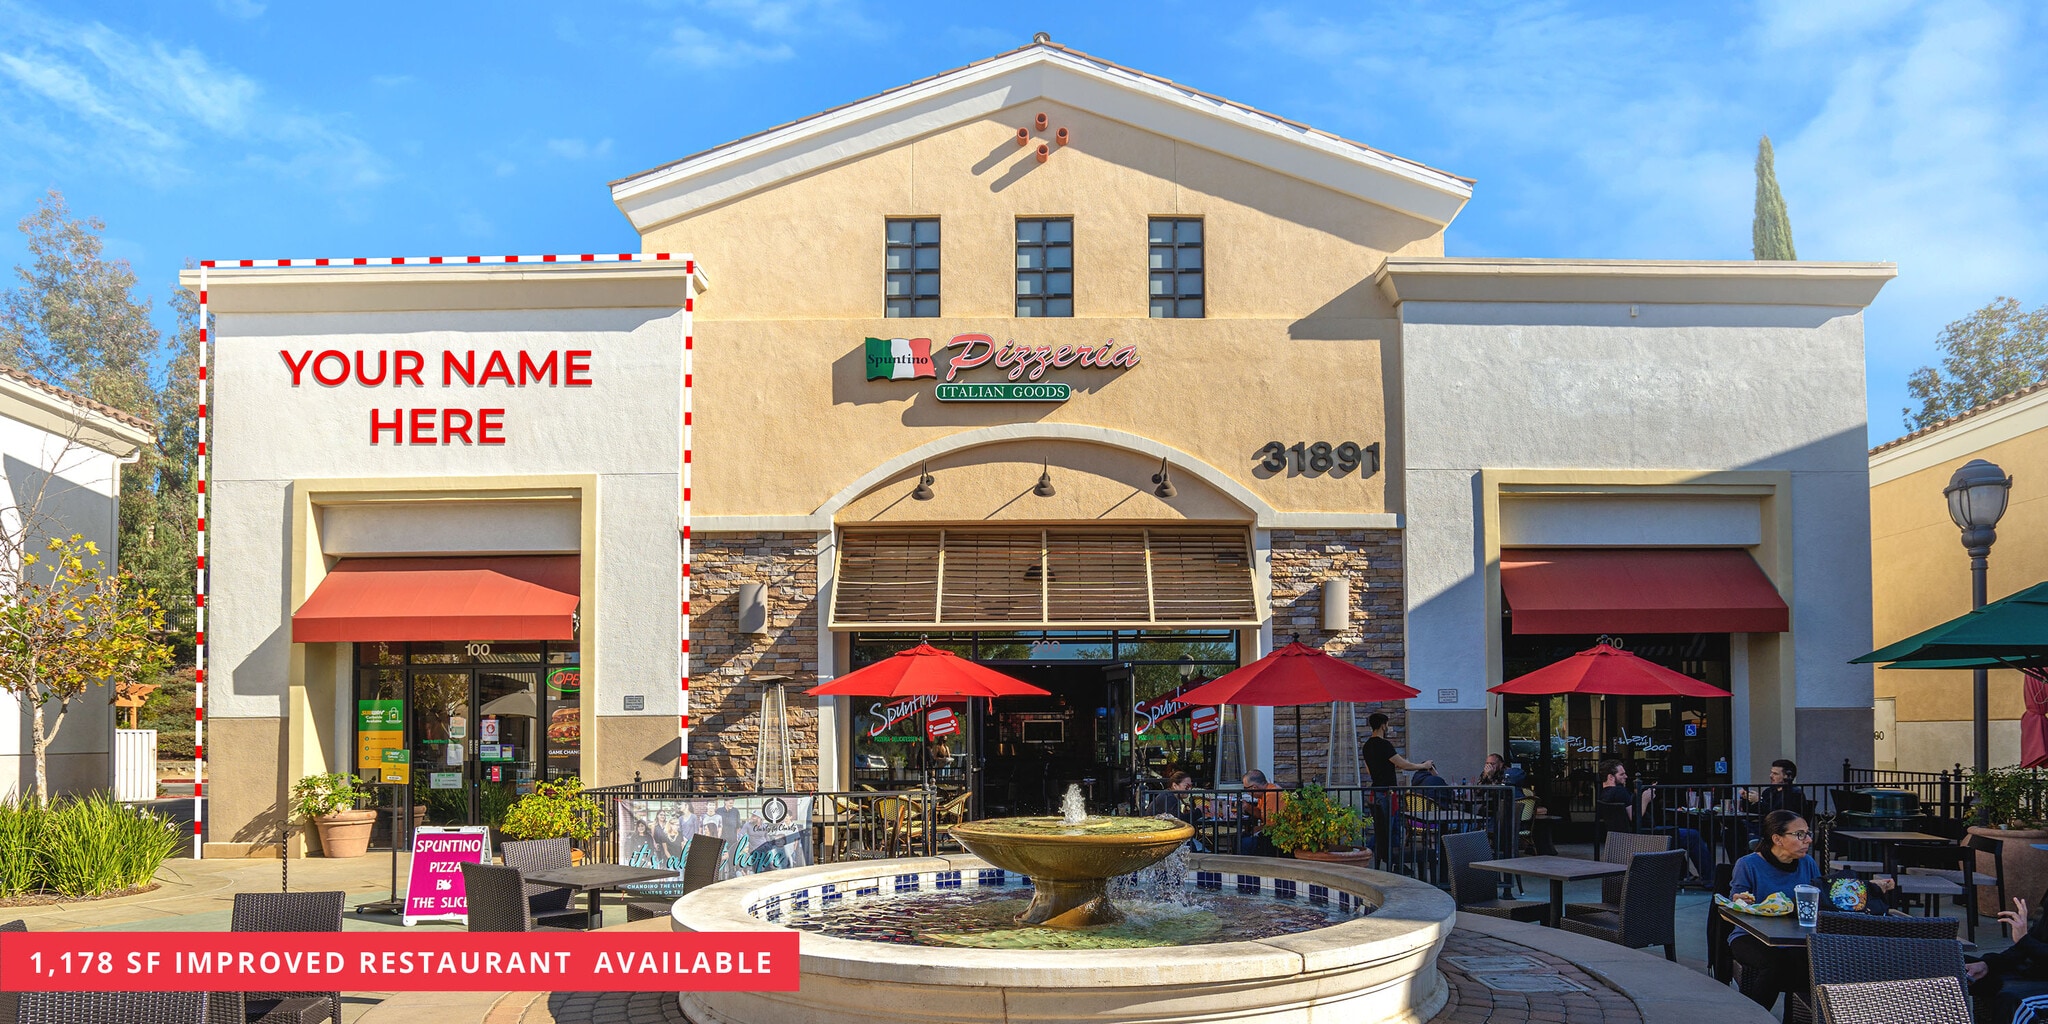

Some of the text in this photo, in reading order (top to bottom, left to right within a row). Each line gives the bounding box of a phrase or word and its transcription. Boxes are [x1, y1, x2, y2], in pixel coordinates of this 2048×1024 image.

[867, 353, 929, 368] Spuntino
[945, 332, 1140, 382] Pizzeria
[941, 385, 1065, 398] ITALIAN GOODS
[1262, 440, 1380, 473] 31891
[464, 643, 491, 657] 100
[1032, 640, 1061, 654] 200
[554, 672, 581, 686] OPE
[1643, 737, 1672, 752] door
[416, 839, 481, 853] SPUNTINO
[733, 832, 786, 874] hope
[429, 861, 462, 873] PIZZA
[412, 897, 435, 909] THE
